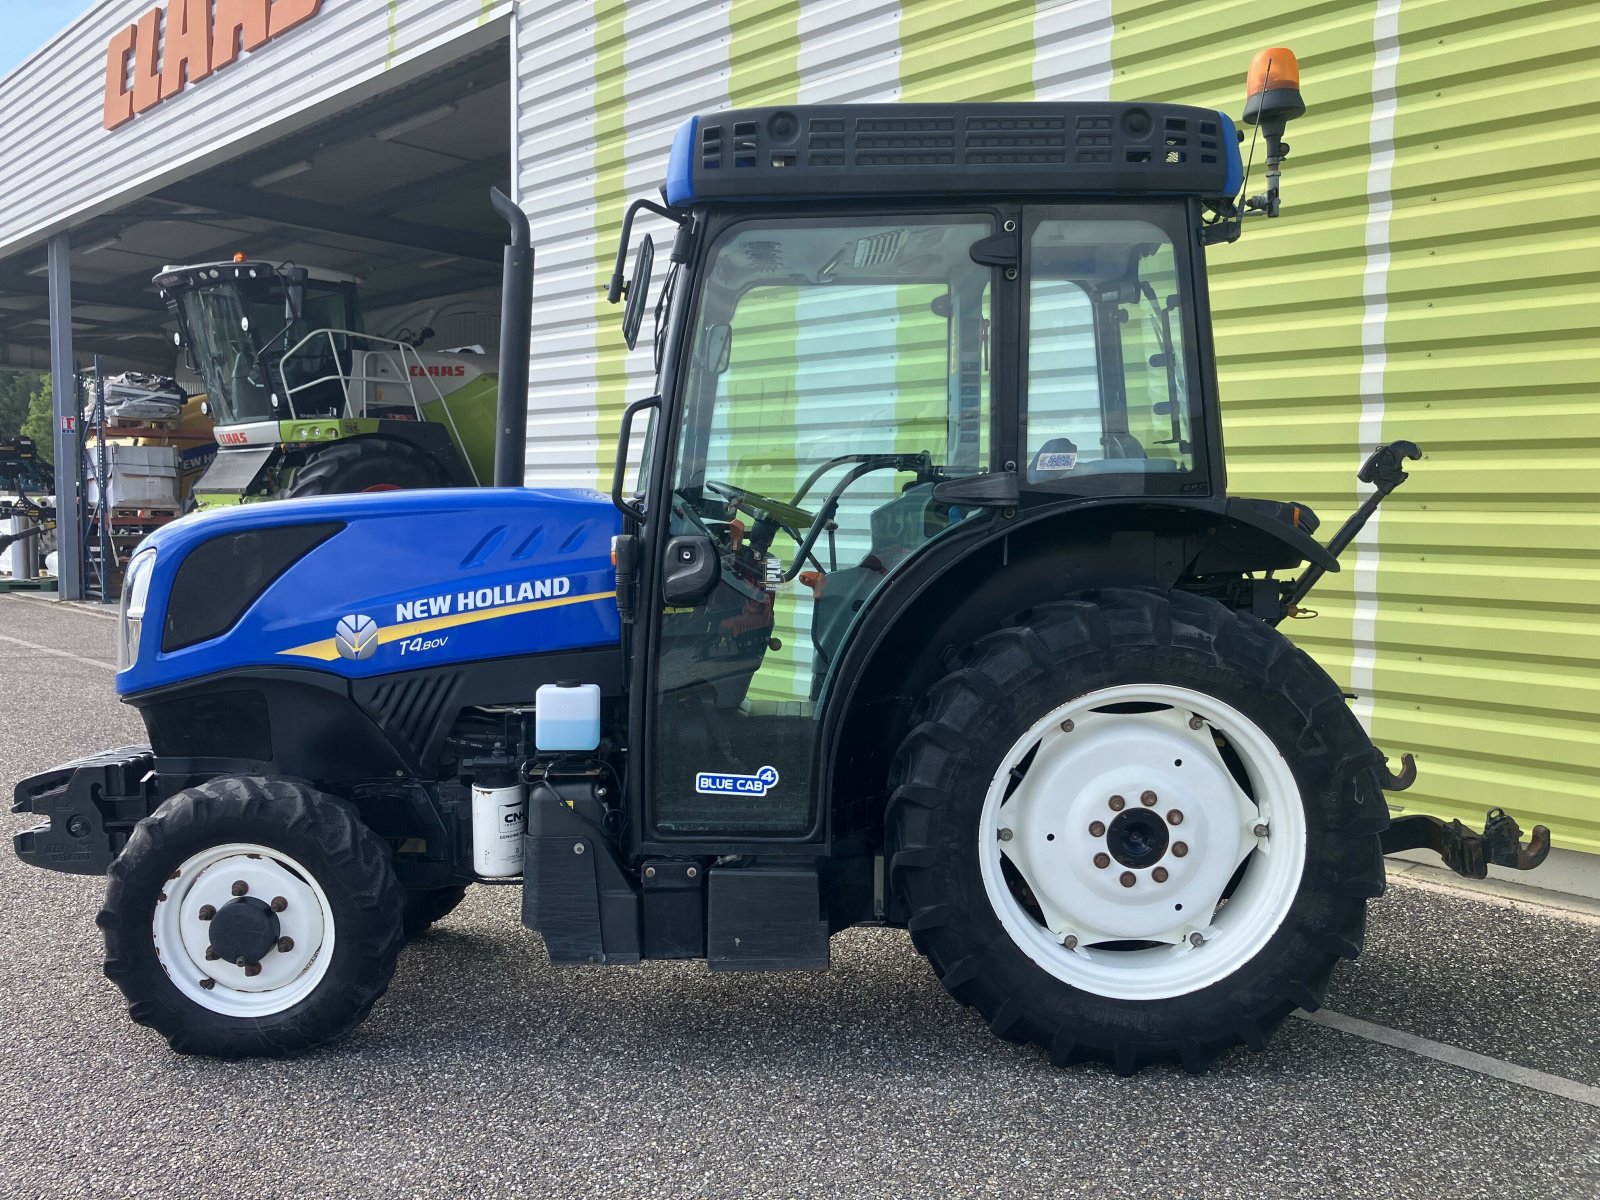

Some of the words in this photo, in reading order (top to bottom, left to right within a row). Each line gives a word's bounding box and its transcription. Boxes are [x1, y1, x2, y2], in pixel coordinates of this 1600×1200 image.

[104, 0, 323, 131] CLAA
[410, 366, 464, 376] CLAAS
[396, 595, 451, 622] NEW
[457, 577, 570, 612] HOLLAND
[400, 636, 448, 656] T4.80V
[700, 777, 733, 790] BLUE
[736, 780, 763, 791] CAB
[760, 770, 775, 783] 4
